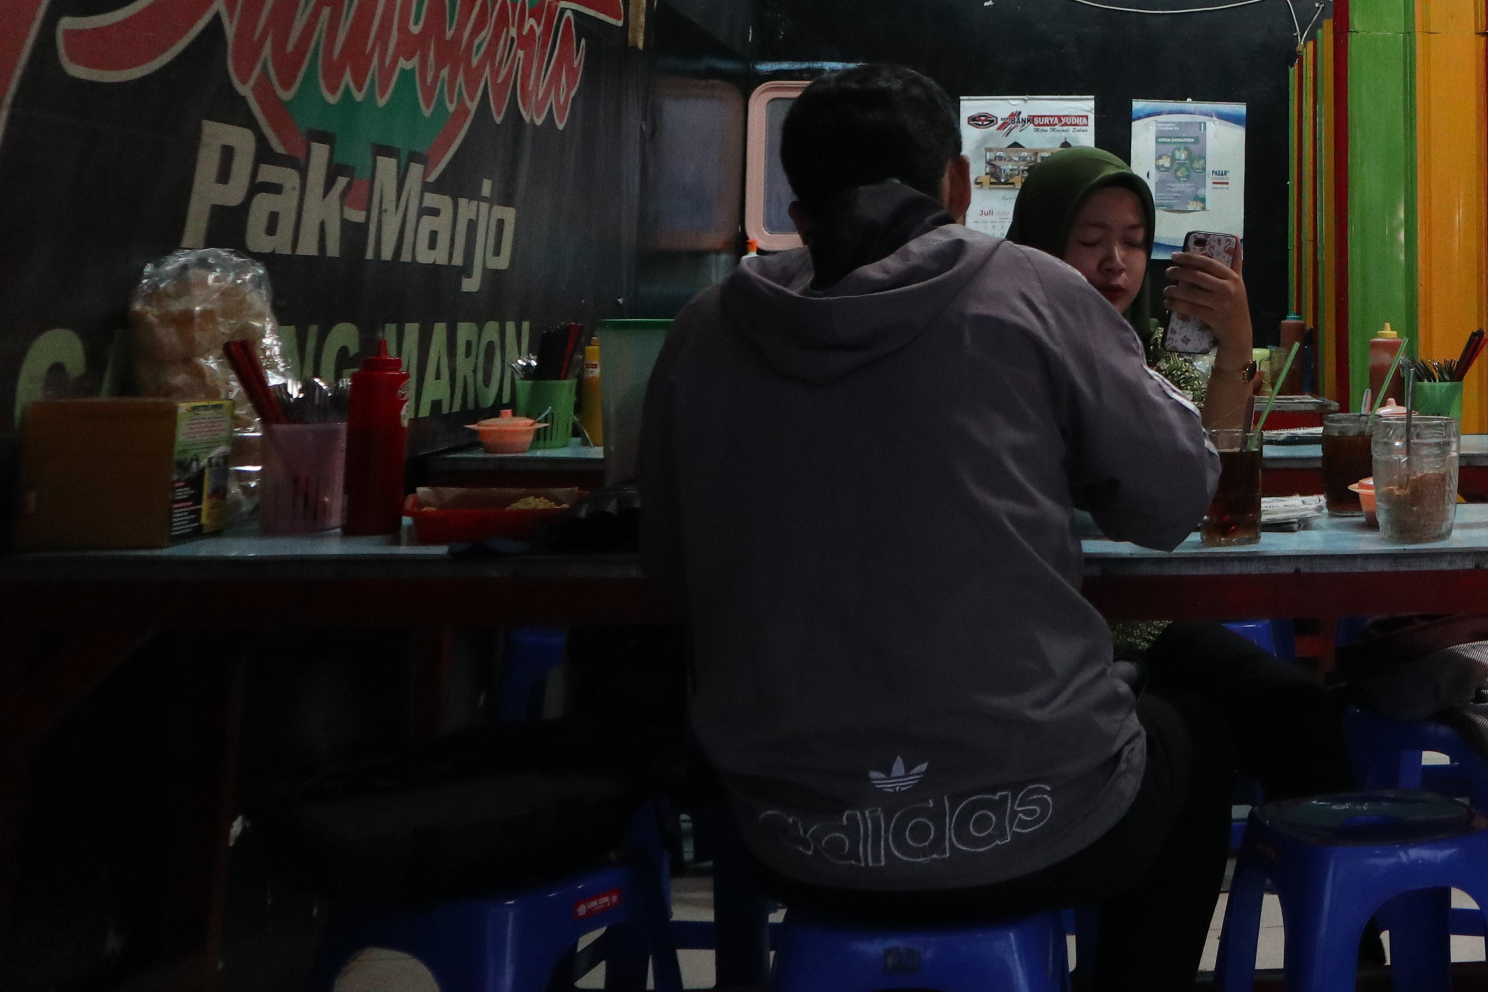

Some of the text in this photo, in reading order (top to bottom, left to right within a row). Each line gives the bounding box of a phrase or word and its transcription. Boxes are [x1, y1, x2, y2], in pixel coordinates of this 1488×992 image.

[1010, 117, 1032, 125] BANK
[1033, 117, 1059, 125] SURYA
[1060, 117, 1087, 125] YUDHA
[178, 118, 517, 293] Pak Marjo
[758, 783, 1053, 868] adidas
